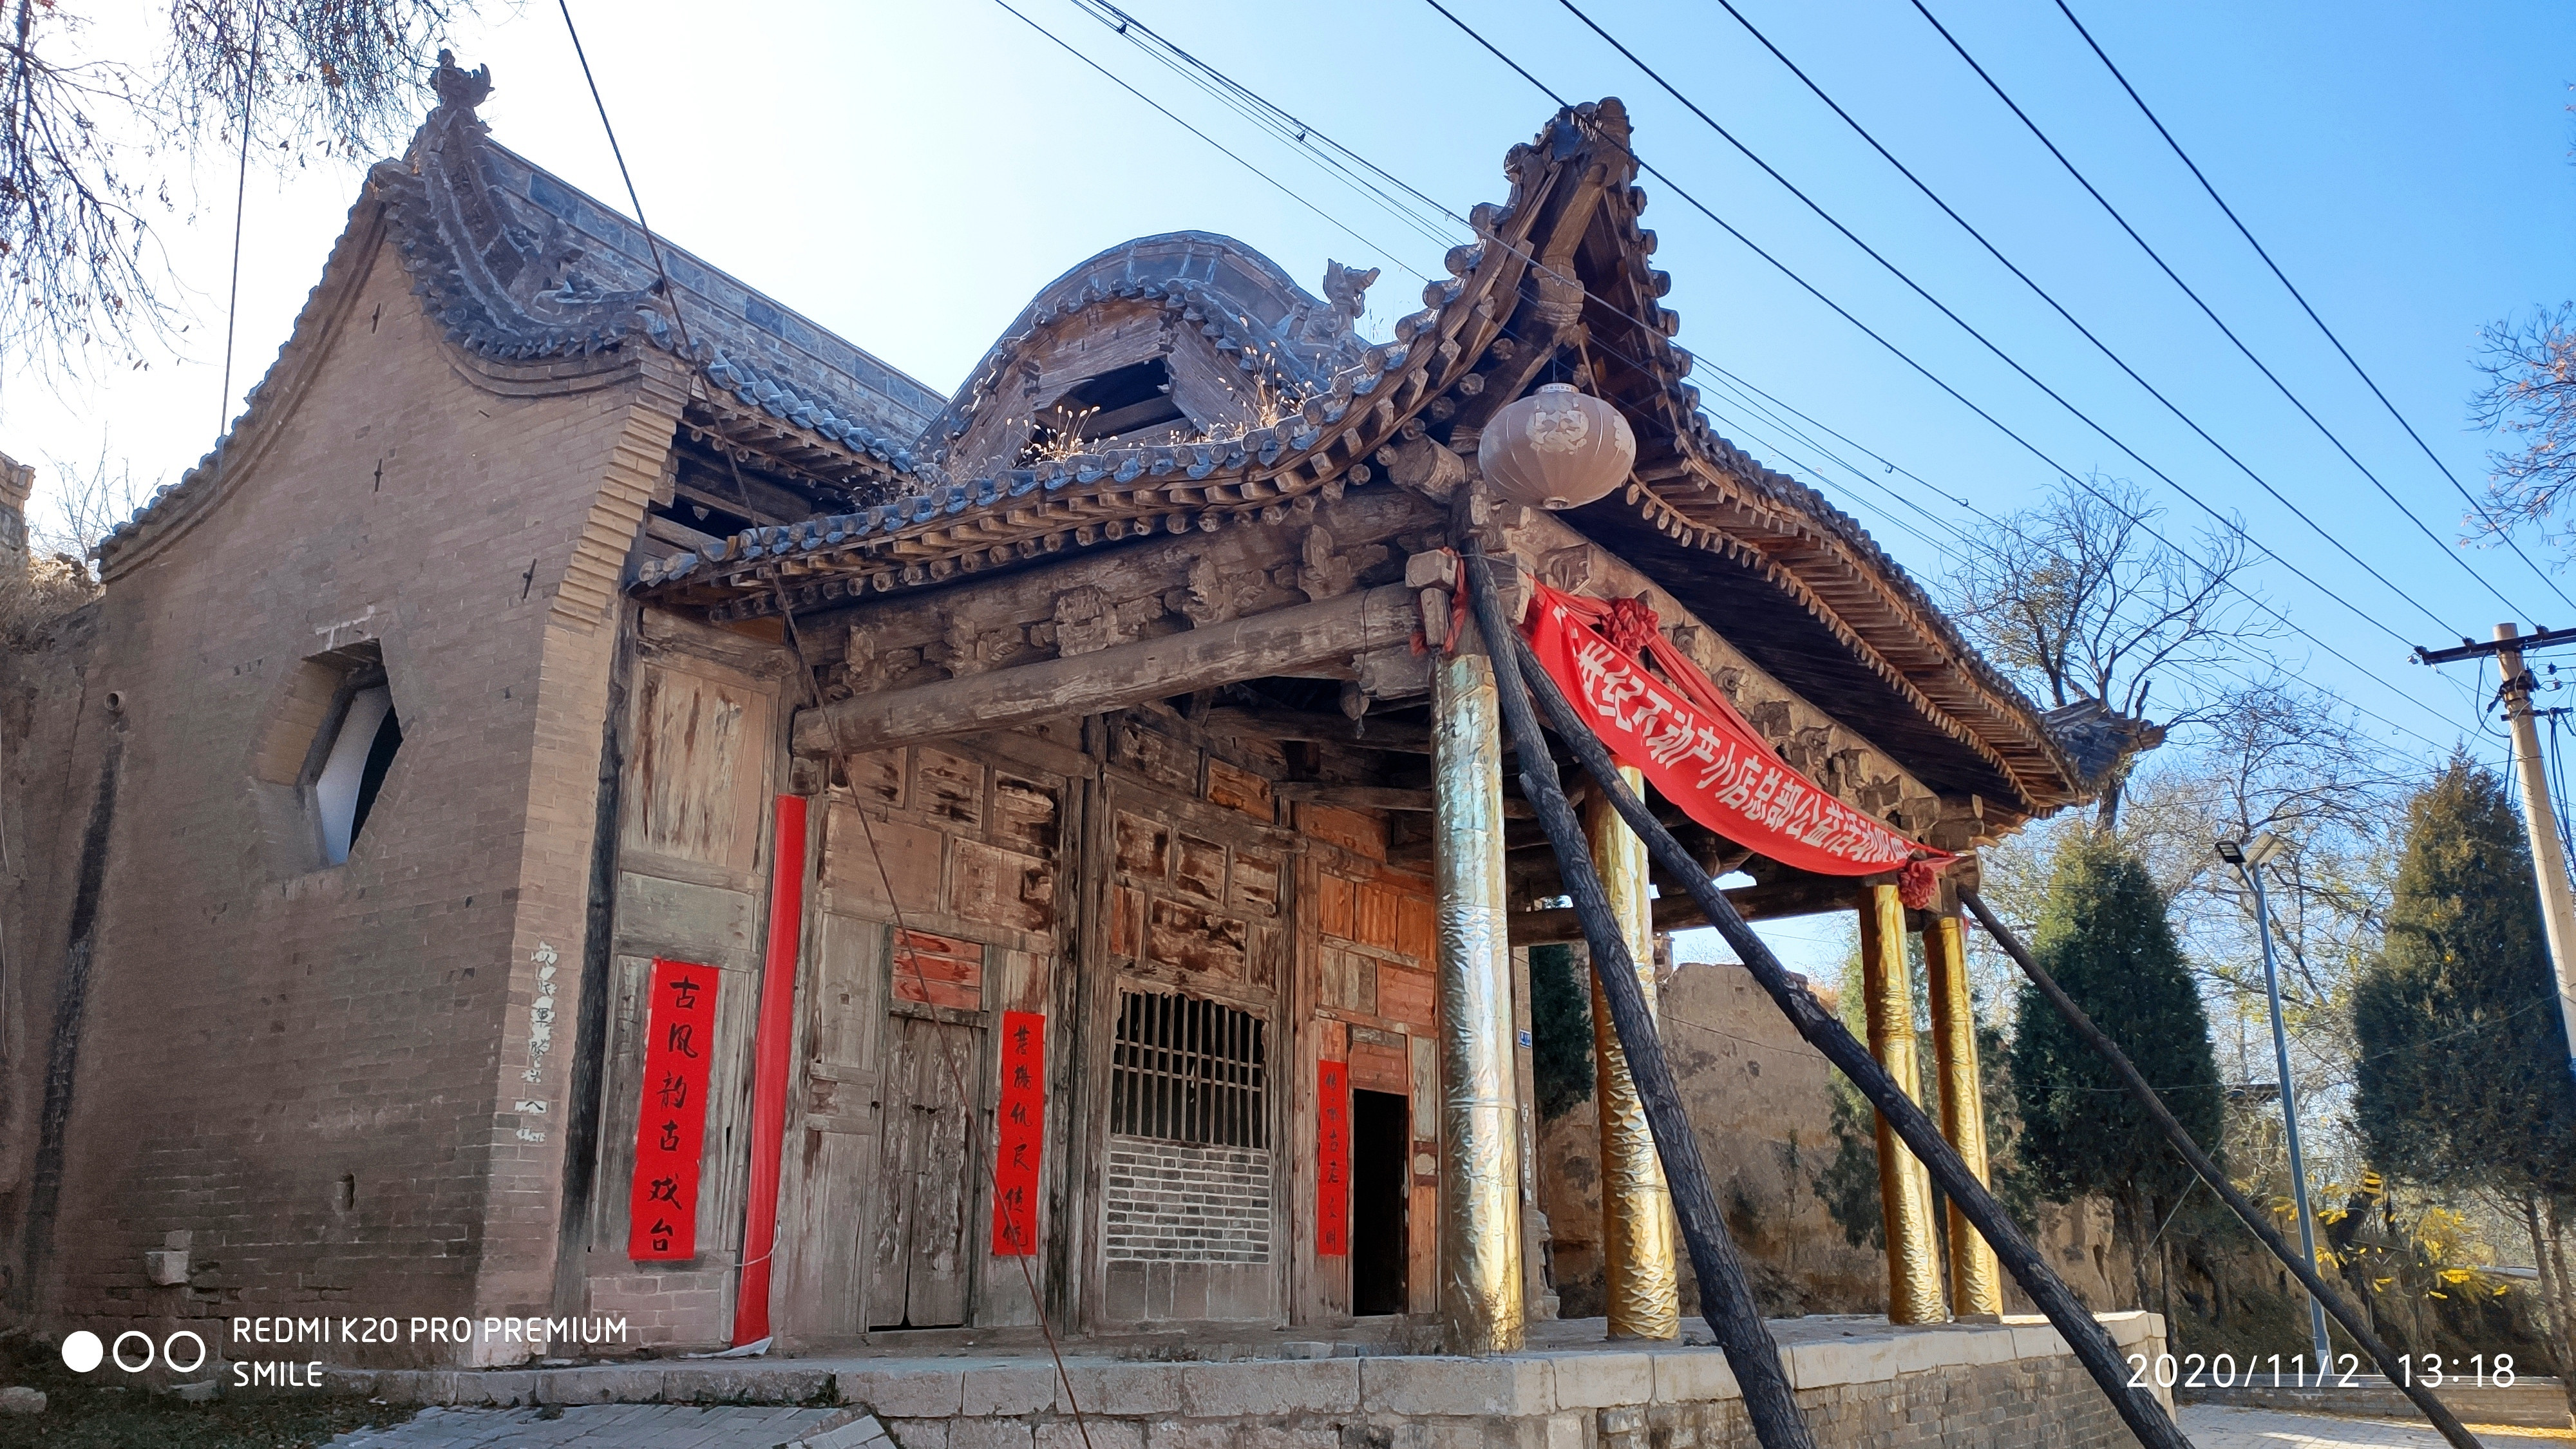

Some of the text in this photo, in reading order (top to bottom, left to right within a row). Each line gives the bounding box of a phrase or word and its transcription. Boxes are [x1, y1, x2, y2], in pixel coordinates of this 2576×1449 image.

[648, 975, 701, 1252] 古风韵古戏台
